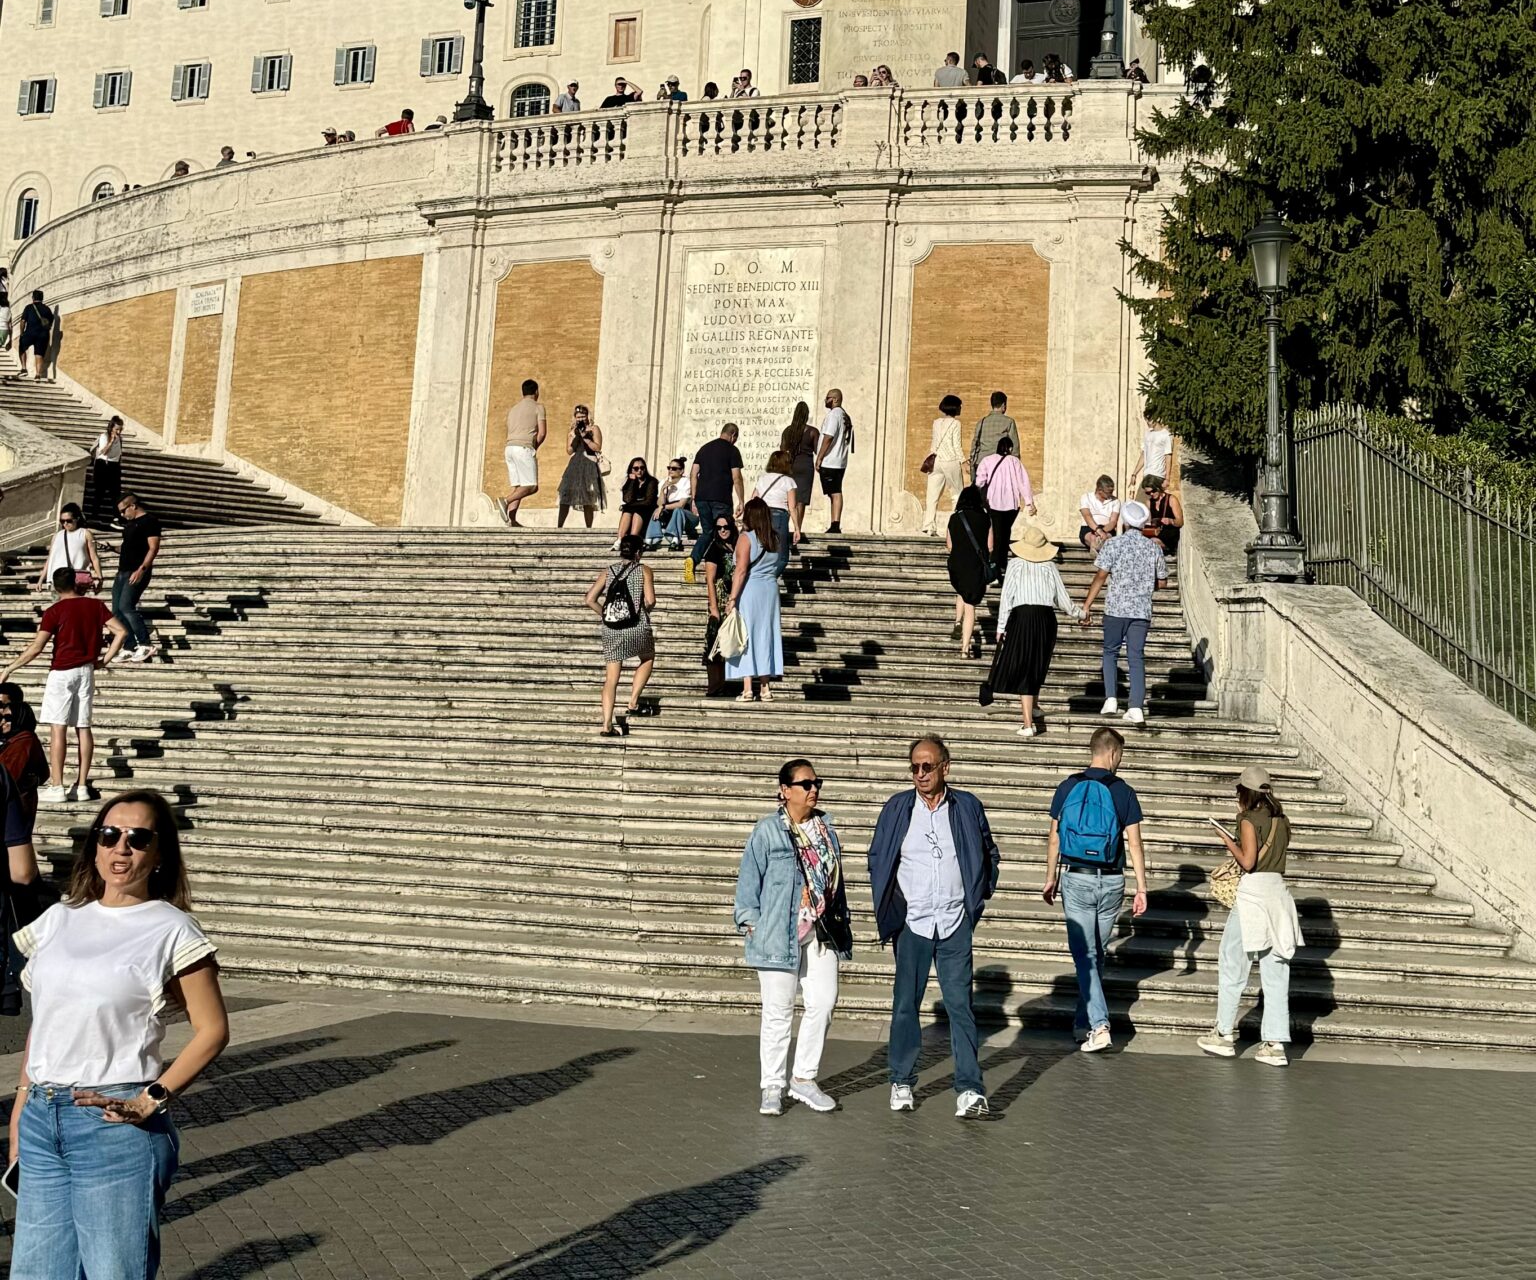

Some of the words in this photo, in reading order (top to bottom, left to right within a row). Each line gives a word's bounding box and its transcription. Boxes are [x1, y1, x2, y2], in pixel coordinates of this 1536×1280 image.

[687, 283, 733, 294] SEDENTE
[737, 281, 796, 293] BENEDICTO
[800, 280, 819, 291] XIII
[703, 314, 772, 326] LUDOVICO
[686, 331, 698, 342] IN
[701, 331, 745, 342] GALLIIS
[749, 329, 814, 341] REGNANTE
[740, 346, 778, 355] SANCTAM
[781, 345, 809, 353] SEDEM
[684, 368, 744, 379] MELCHIORE
[758, 381, 810, 392] POLIGNAC
